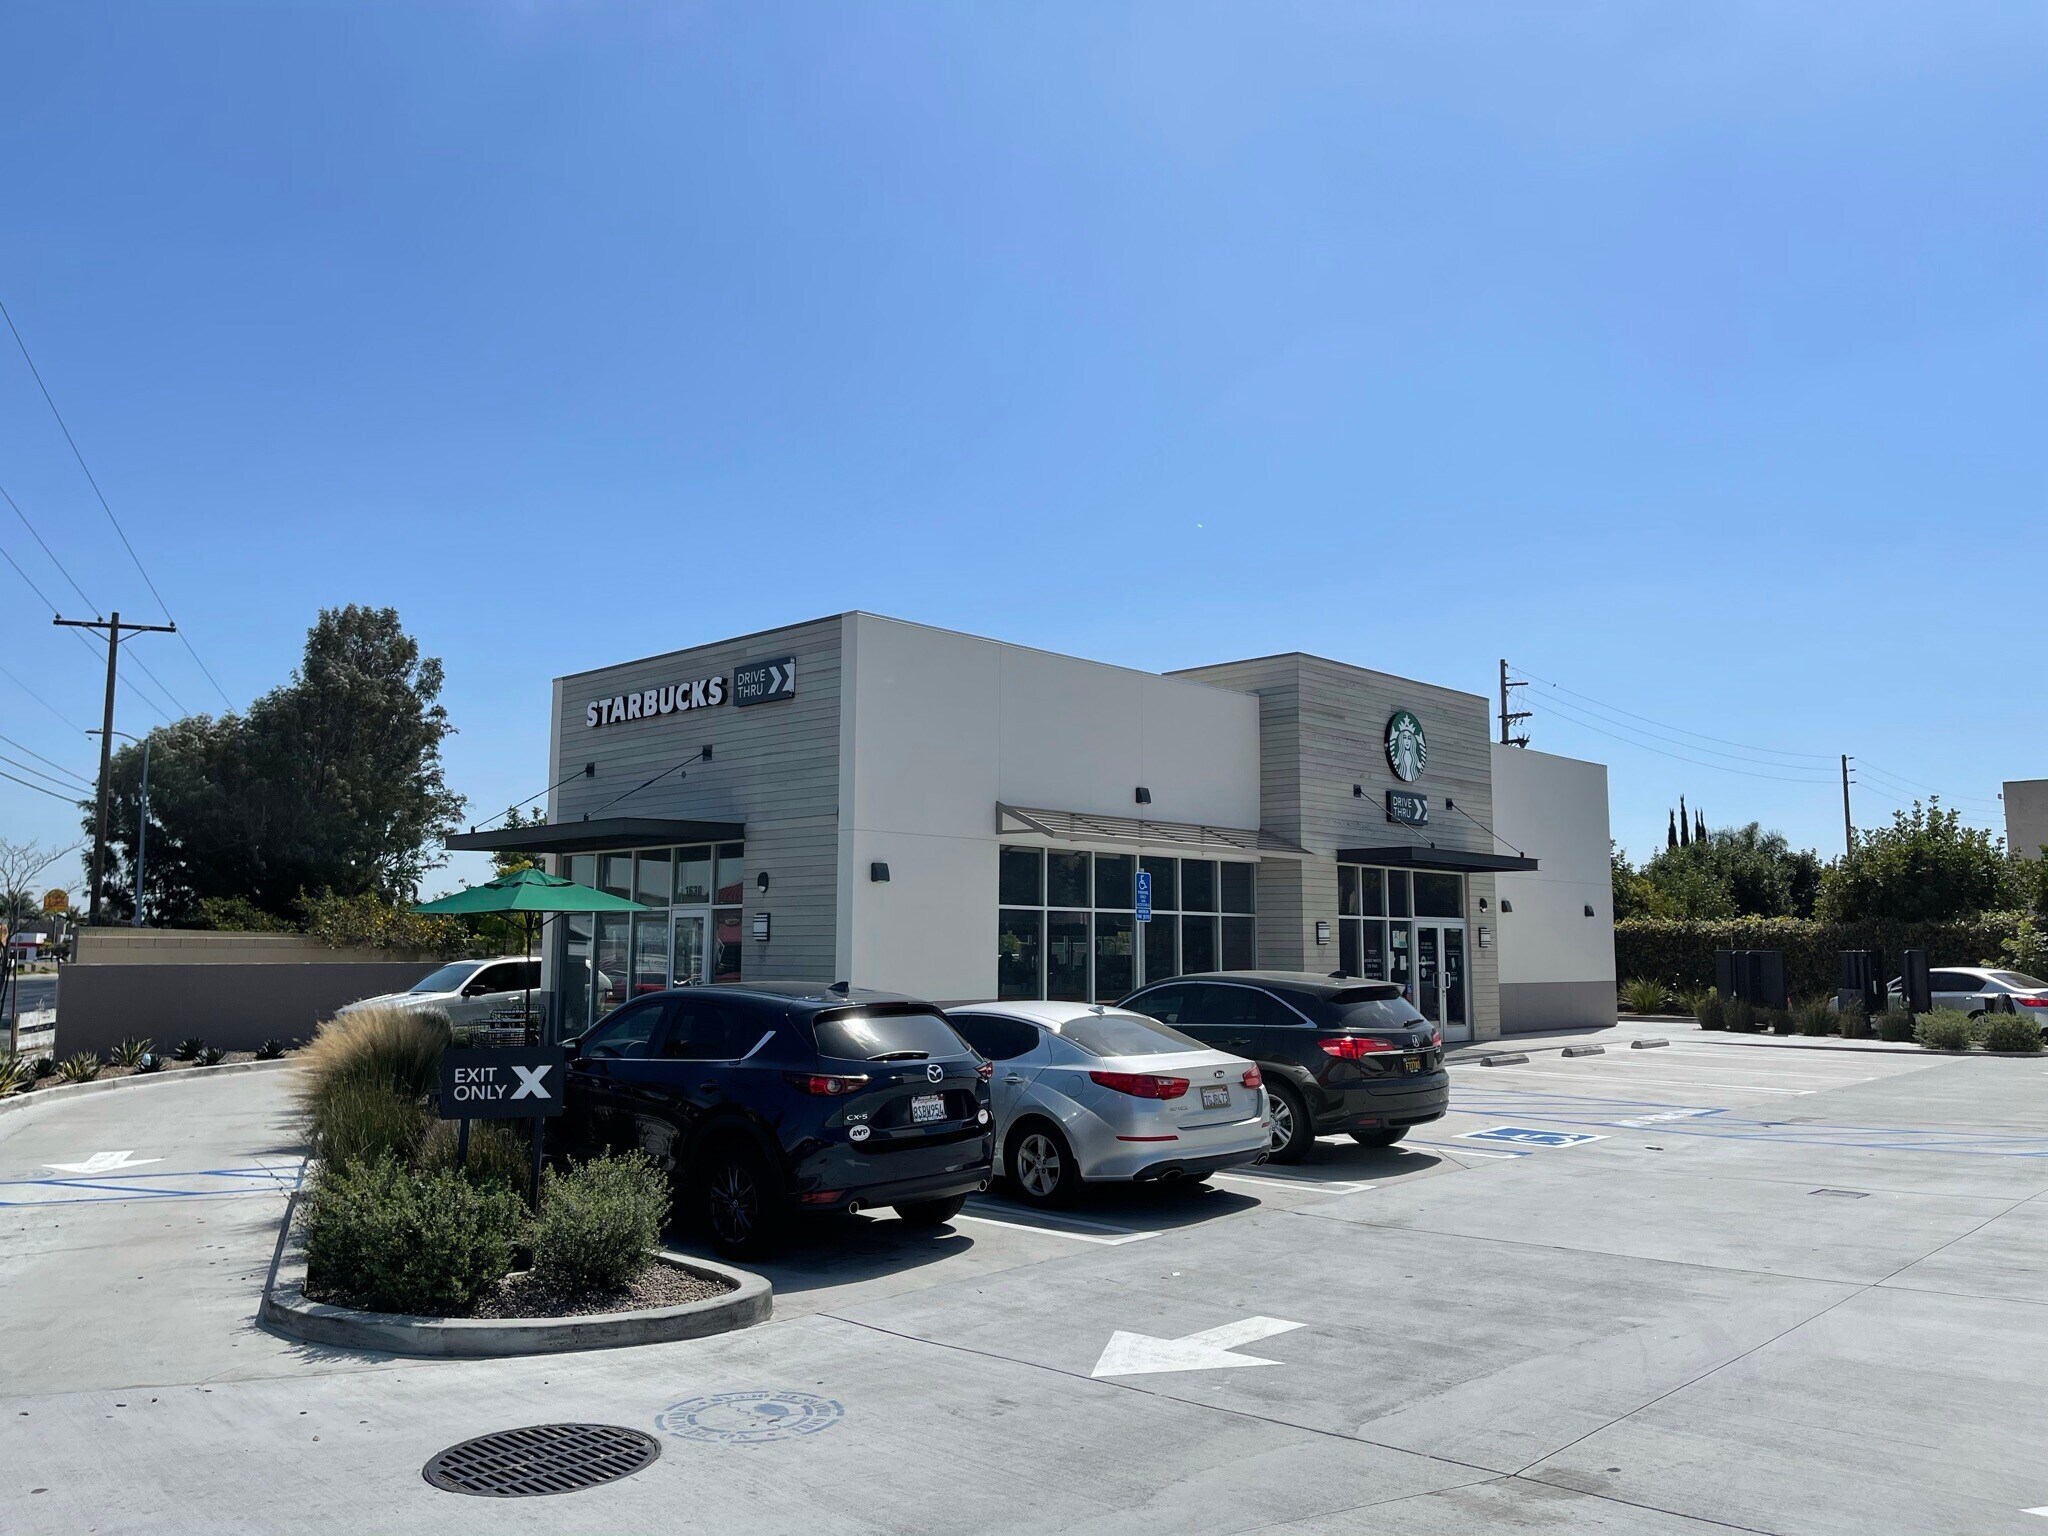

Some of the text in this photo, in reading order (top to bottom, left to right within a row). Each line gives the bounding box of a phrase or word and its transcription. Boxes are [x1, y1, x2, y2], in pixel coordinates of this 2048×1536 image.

[737, 669, 766, 686] DRIVE
[738, 683, 764, 699] THRU
[586, 676, 726, 727] STARBUCKS
[1393, 796, 1412, 808] DRIVE
[1393, 807, 1411, 818] THRU
[454, 1067, 498, 1083] EXIT
[453, 1084, 507, 1101] ONLY
